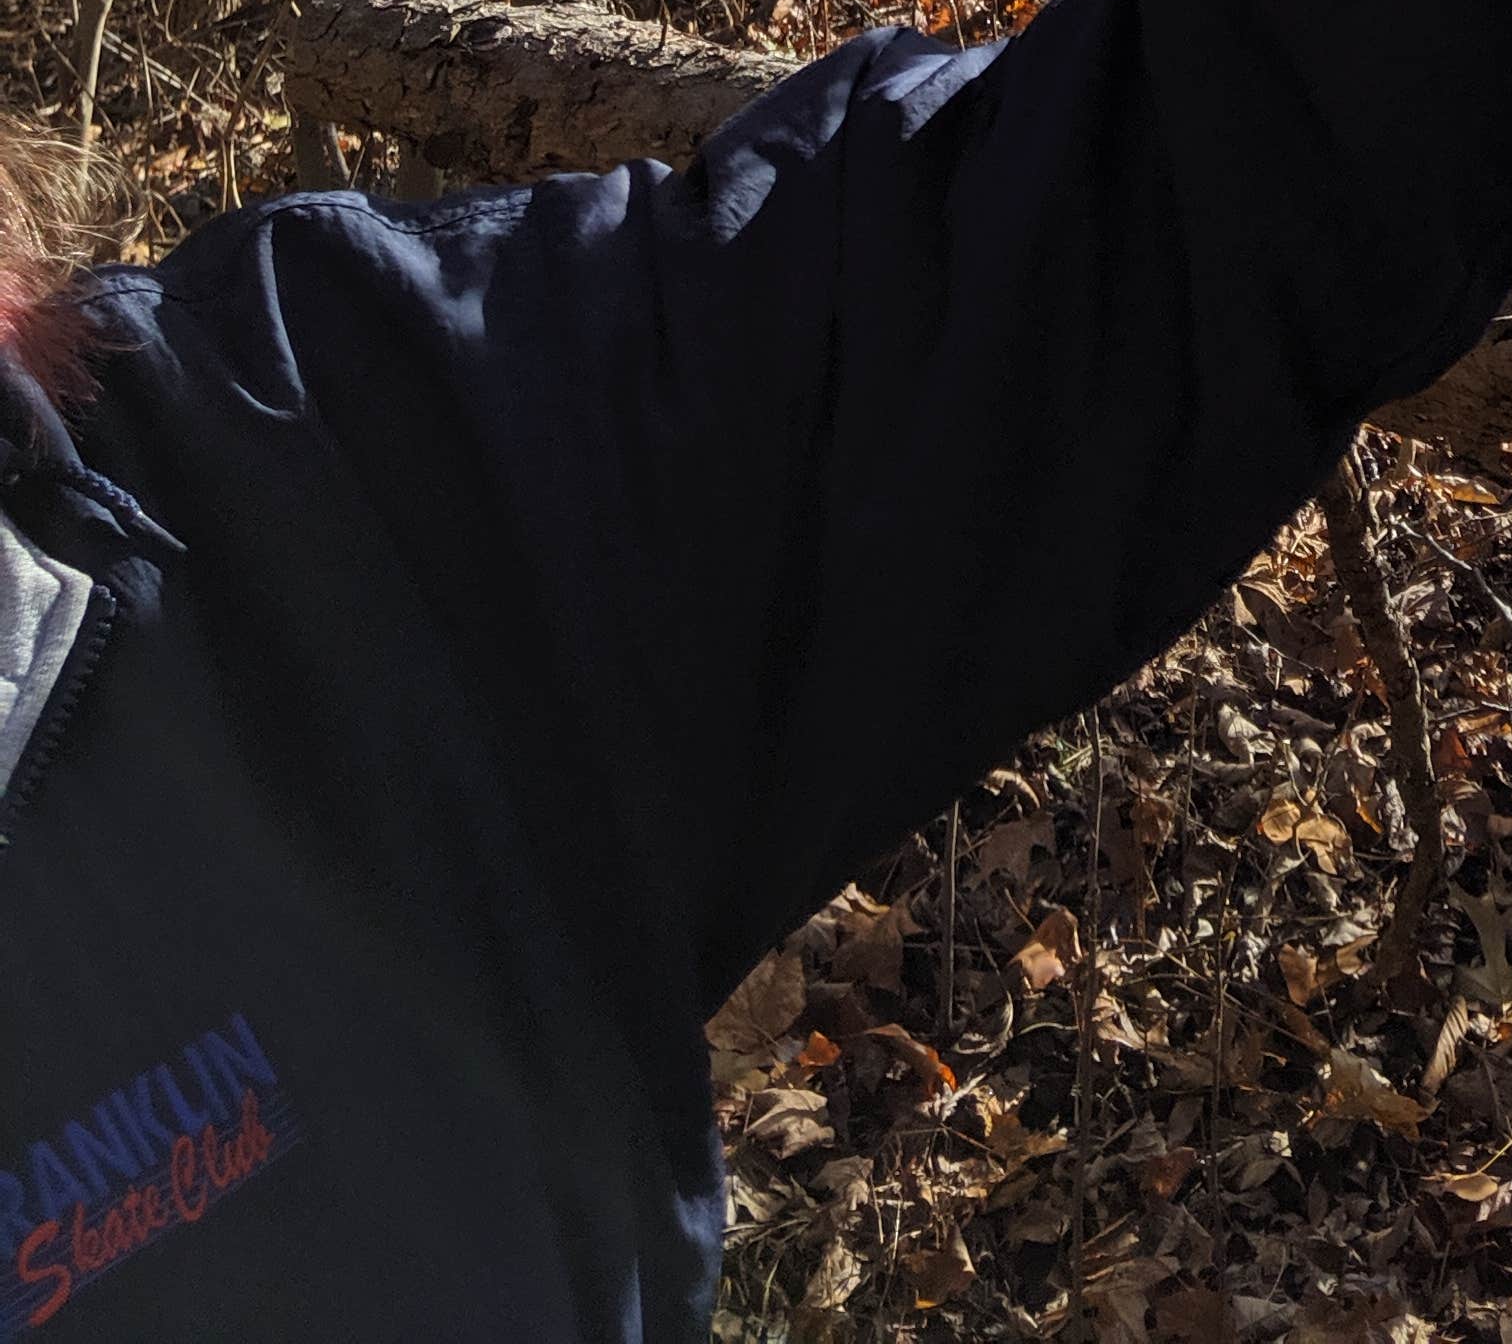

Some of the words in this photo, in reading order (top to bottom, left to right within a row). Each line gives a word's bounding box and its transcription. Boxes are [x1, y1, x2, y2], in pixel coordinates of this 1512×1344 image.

[0, 1011, 277, 1264] RANKLIN
[17, 1186, 169, 1327] Skate
[170, 1087, 275, 1222] Club
